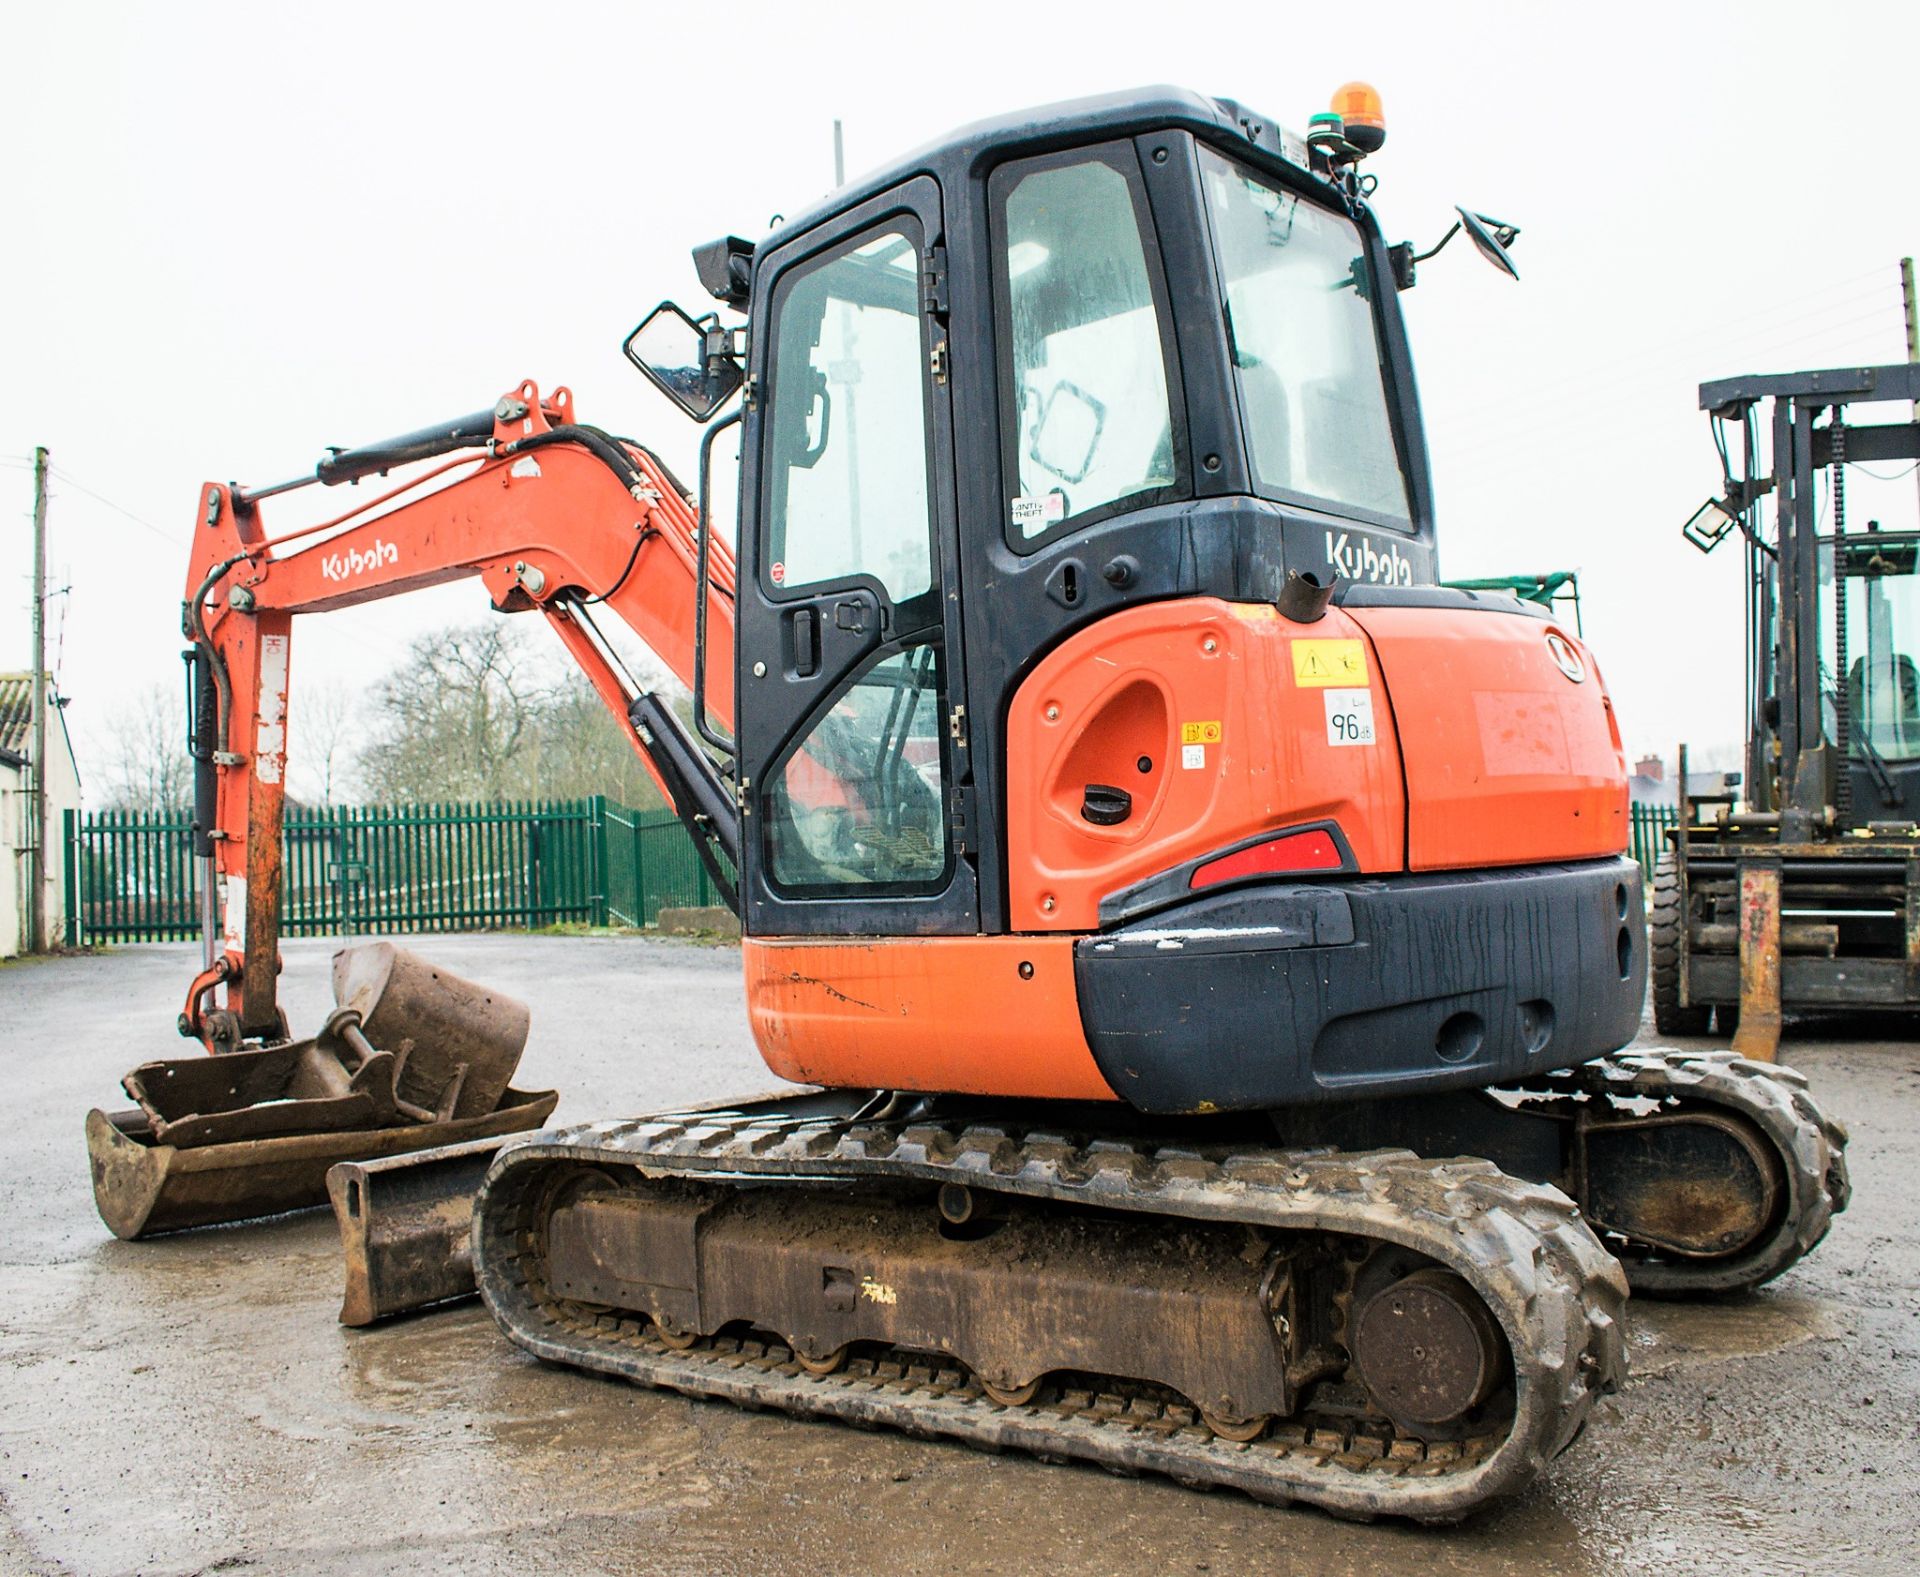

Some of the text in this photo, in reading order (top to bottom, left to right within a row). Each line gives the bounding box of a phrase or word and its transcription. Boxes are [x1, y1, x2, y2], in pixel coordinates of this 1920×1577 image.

[1014, 509, 1043, 518] THEFT
[321, 539, 399, 582] Kubota
[1325, 531, 1412, 587] Kubota
[1332, 713, 1359, 740] 96
